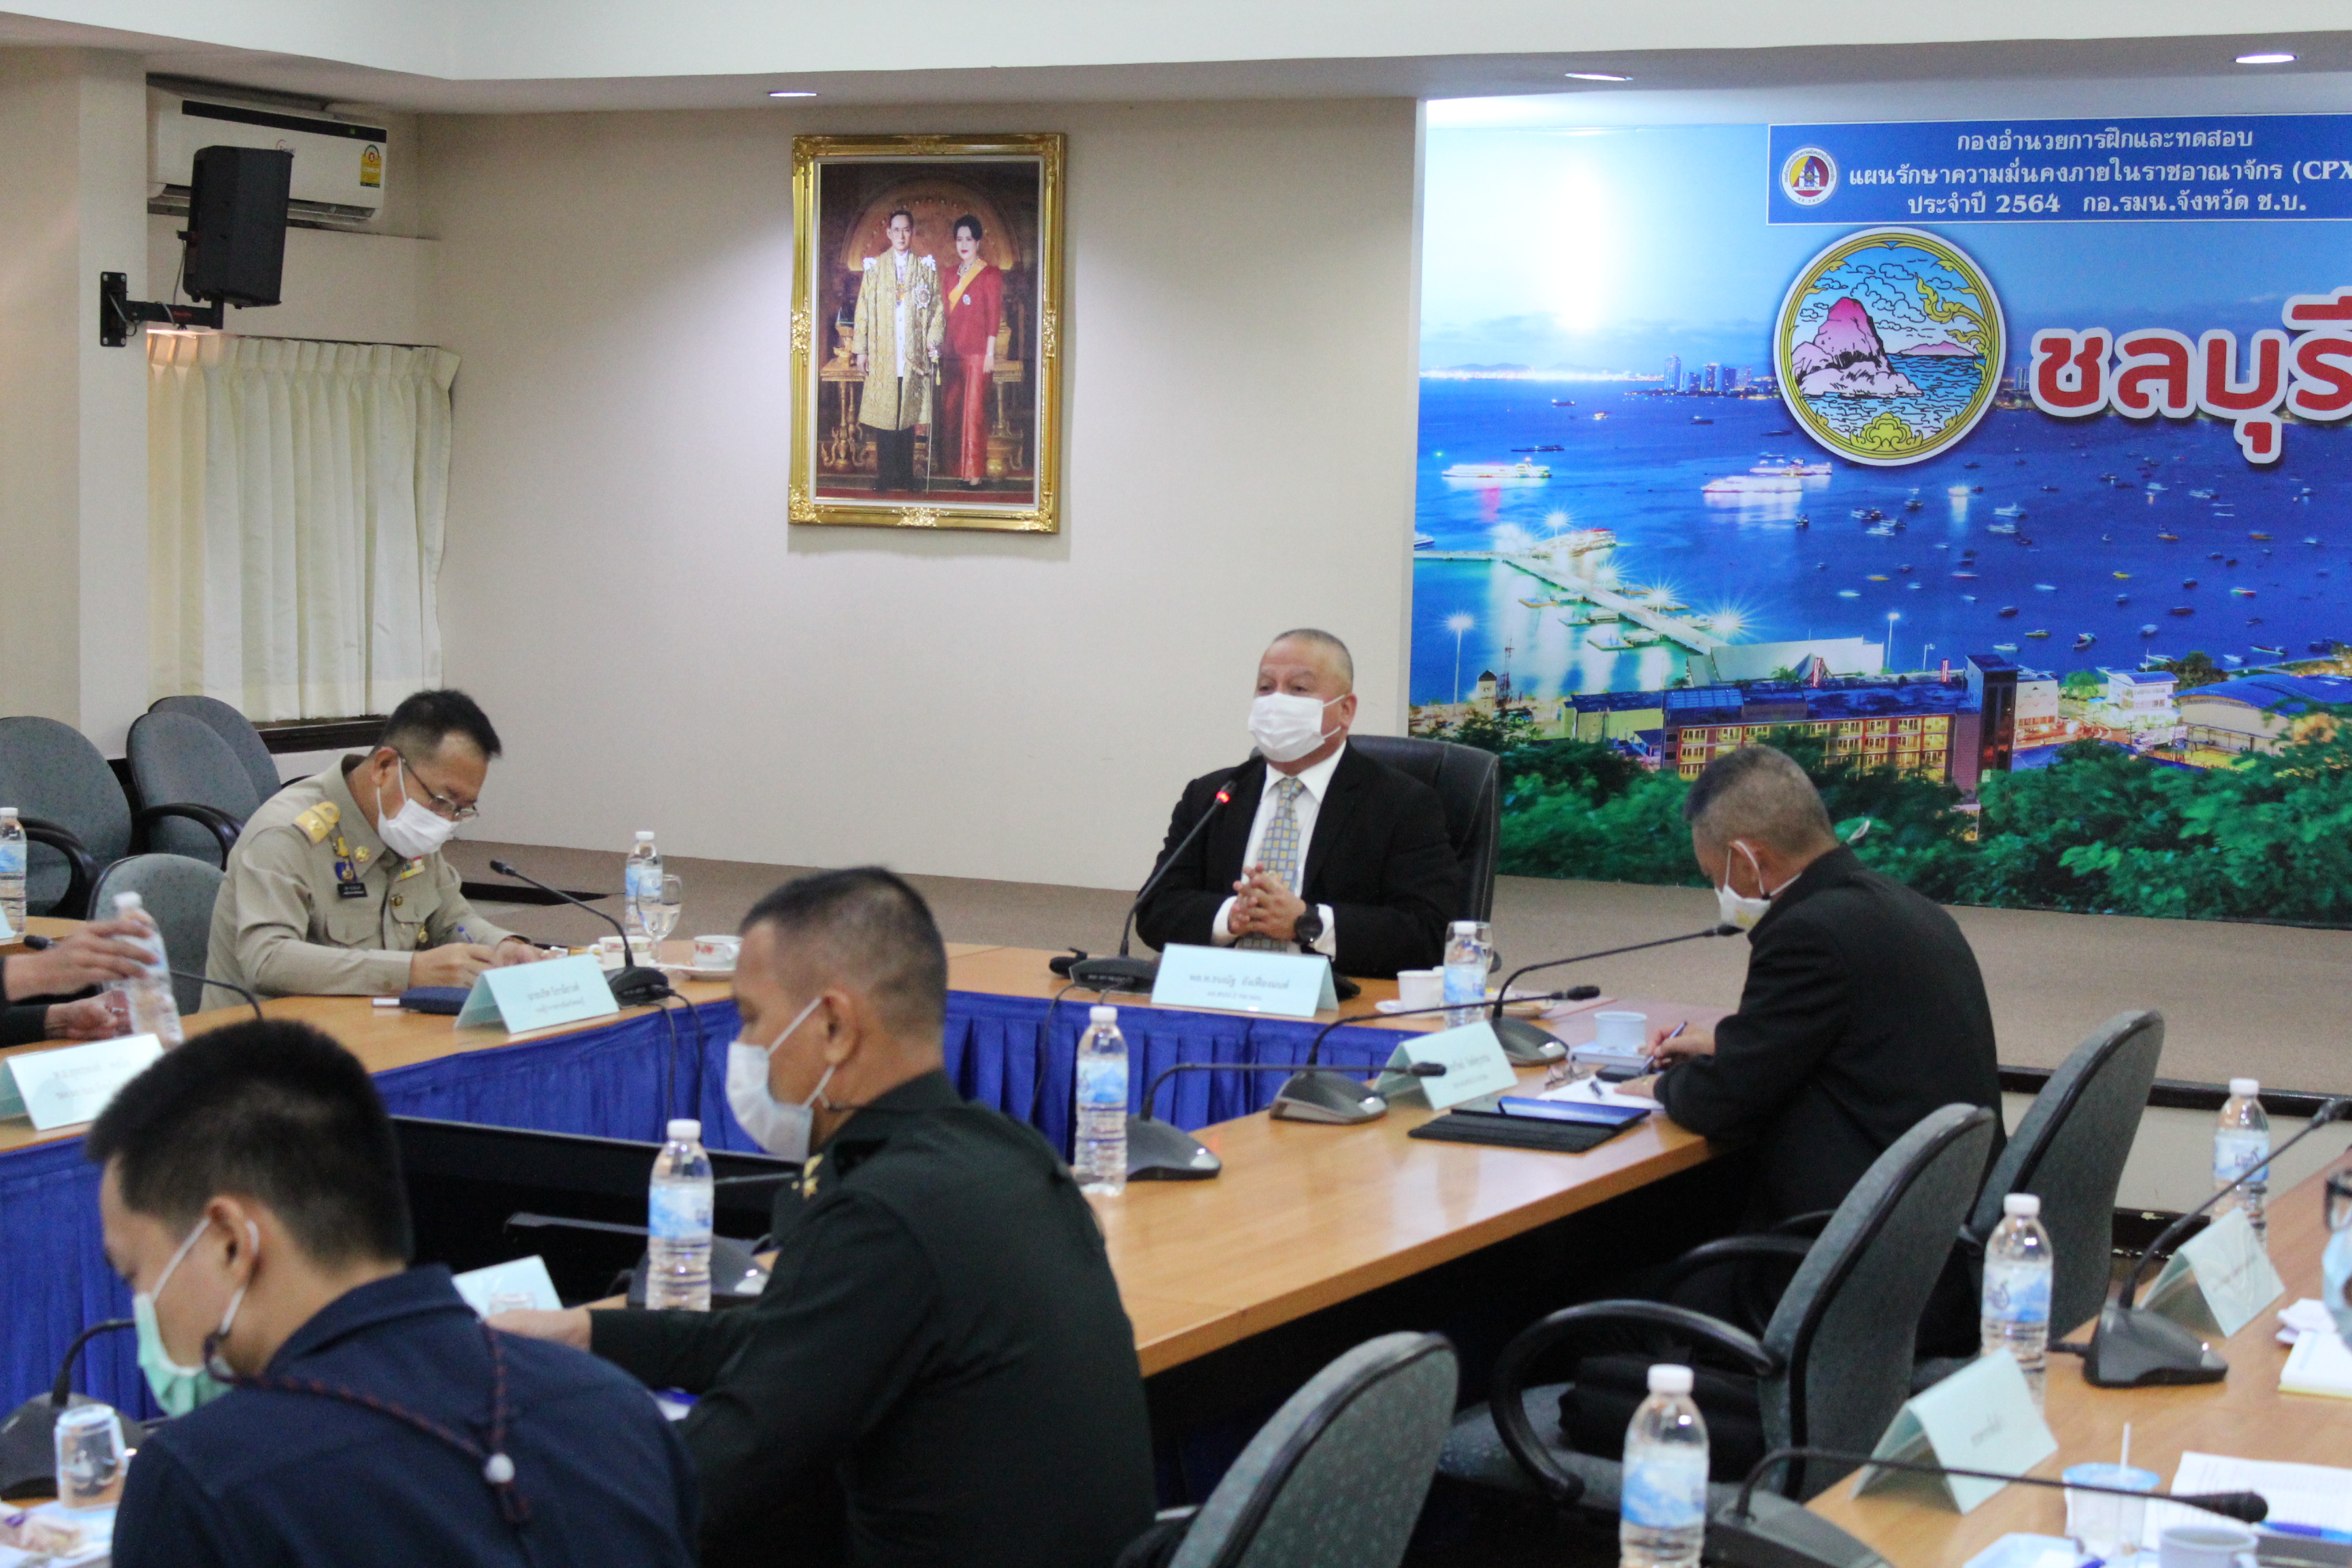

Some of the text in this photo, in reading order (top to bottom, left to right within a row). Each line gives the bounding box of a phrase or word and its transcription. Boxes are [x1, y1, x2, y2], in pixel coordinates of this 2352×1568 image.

[1957, 127, 2254, 151] กองอำนวยการฝึกและทดสอบ
[1850, 157, 2284, 185] แผนรักษาความมั่นคงภายในราชอาณาจักร
[1908, 189, 2308, 214] ประจำปี 2564 กอ.รมน.จังหวัด ช.บ.
